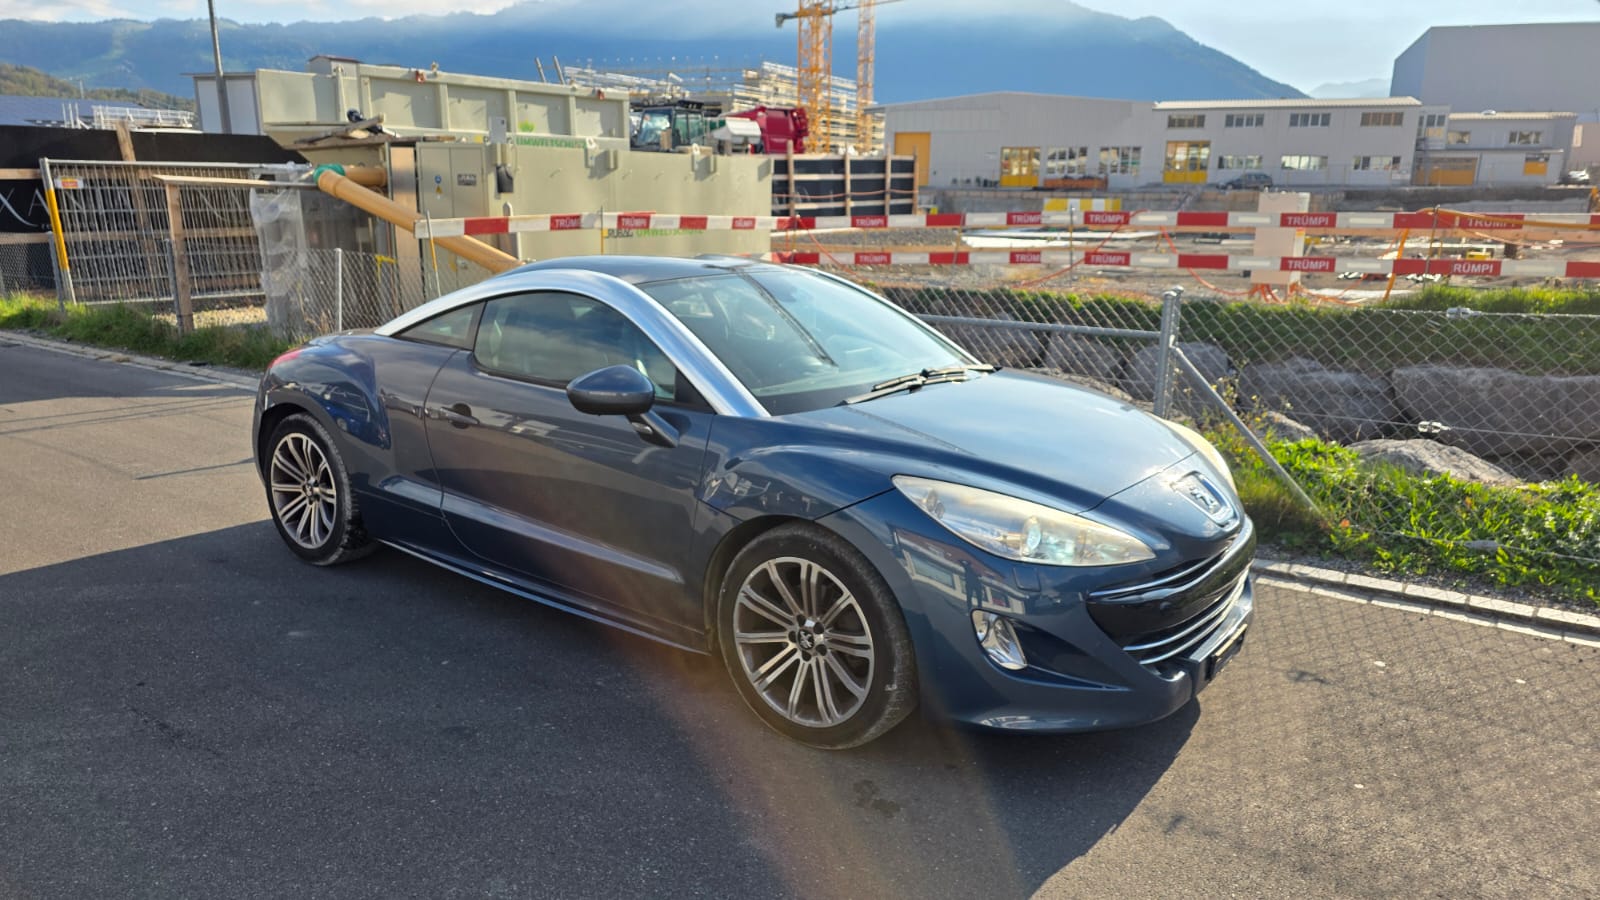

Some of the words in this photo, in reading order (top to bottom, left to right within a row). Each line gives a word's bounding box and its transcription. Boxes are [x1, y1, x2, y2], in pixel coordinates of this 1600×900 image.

[855, 217, 885, 227] TRÜMPI
[1089, 213, 1125, 224] TRÜMPI
[1287, 215, 1329, 226] TRÜMPI
[860, 254, 888, 263] TRÜMPI
[1090, 253, 1126, 264] TRÜMPI
[1287, 259, 1329, 270] TRÜMPI
[1453, 262, 1494, 273] RÜMPI
